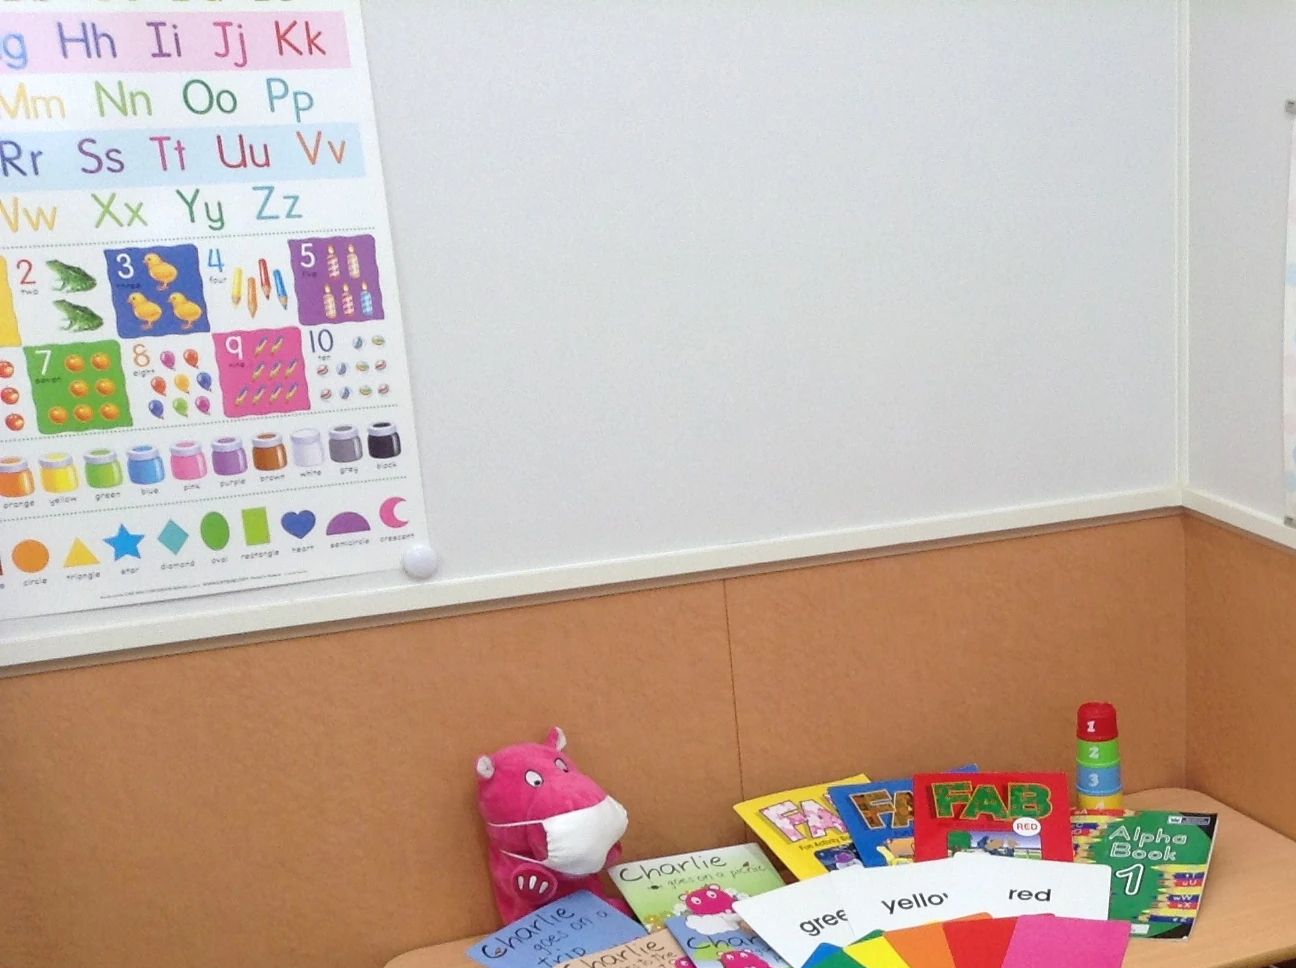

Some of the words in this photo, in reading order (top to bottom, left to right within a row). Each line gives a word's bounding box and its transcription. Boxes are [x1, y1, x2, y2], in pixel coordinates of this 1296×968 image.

[57, 22, 118, 59] Hh
[146, 22, 182, 58] Ii
[213, 21, 248, 68] Jj
[275, 20, 327, 56] Kk
[94, 80, 153, 117] Nn
[182, 79, 238, 115] Oo
[266, 77, 314, 123] Pp
[0, 140, 43, 177] Rr
[77, 138, 125, 174] Ss
[149, 136, 186, 172] Tt
[216, 133, 271, 169] Uu
[296, 131, 346, 165] Vv
[91, 192, 148, 228] Xx
[176, 188, 225, 231] Yy
[252, 186, 304, 220] Zz
[115, 253, 135, 279] 3
[207, 248, 225, 272] 4
[299, 243, 316, 268] 5
[16, 258, 36, 285] 2
[225, 336, 243, 360] 9
[308, 329, 334, 353] 10
[35, 350, 52, 376] 7
[132, 343, 150, 367] 8
[49, 496, 77, 507] yellow
[95, 491, 121, 501] green
[140, 487, 159, 495] blue
[219, 477, 246, 488] purple
[260, 474, 285, 482] brown
[376, 462, 397, 470] black
[66, 571, 101, 581] triangle
[160, 560, 195, 570] diamond
[240, 549, 280, 559] rectangle
[330, 538, 370, 548] semicircle
[1087, 721, 1096, 733] 1
[1089, 747, 1100, 759] 2
[1088, 774, 1099, 787] 3
[931, 781, 1054, 821] FAB
[1016, 822, 1038, 831] RED
[1109, 825, 1187, 848] Alpha
[1110, 843, 1177, 861] Book
[619, 855, 727, 882] Charlie
[1116, 863, 1144, 895] 1
[1009, 888, 1051, 902] red
[482, 905, 575, 960] Charlie
[533, 929, 570, 956] goes
[570, 916, 594, 931] on
[600, 911, 608, 919] a
[537, 946, 586, 968] trip
